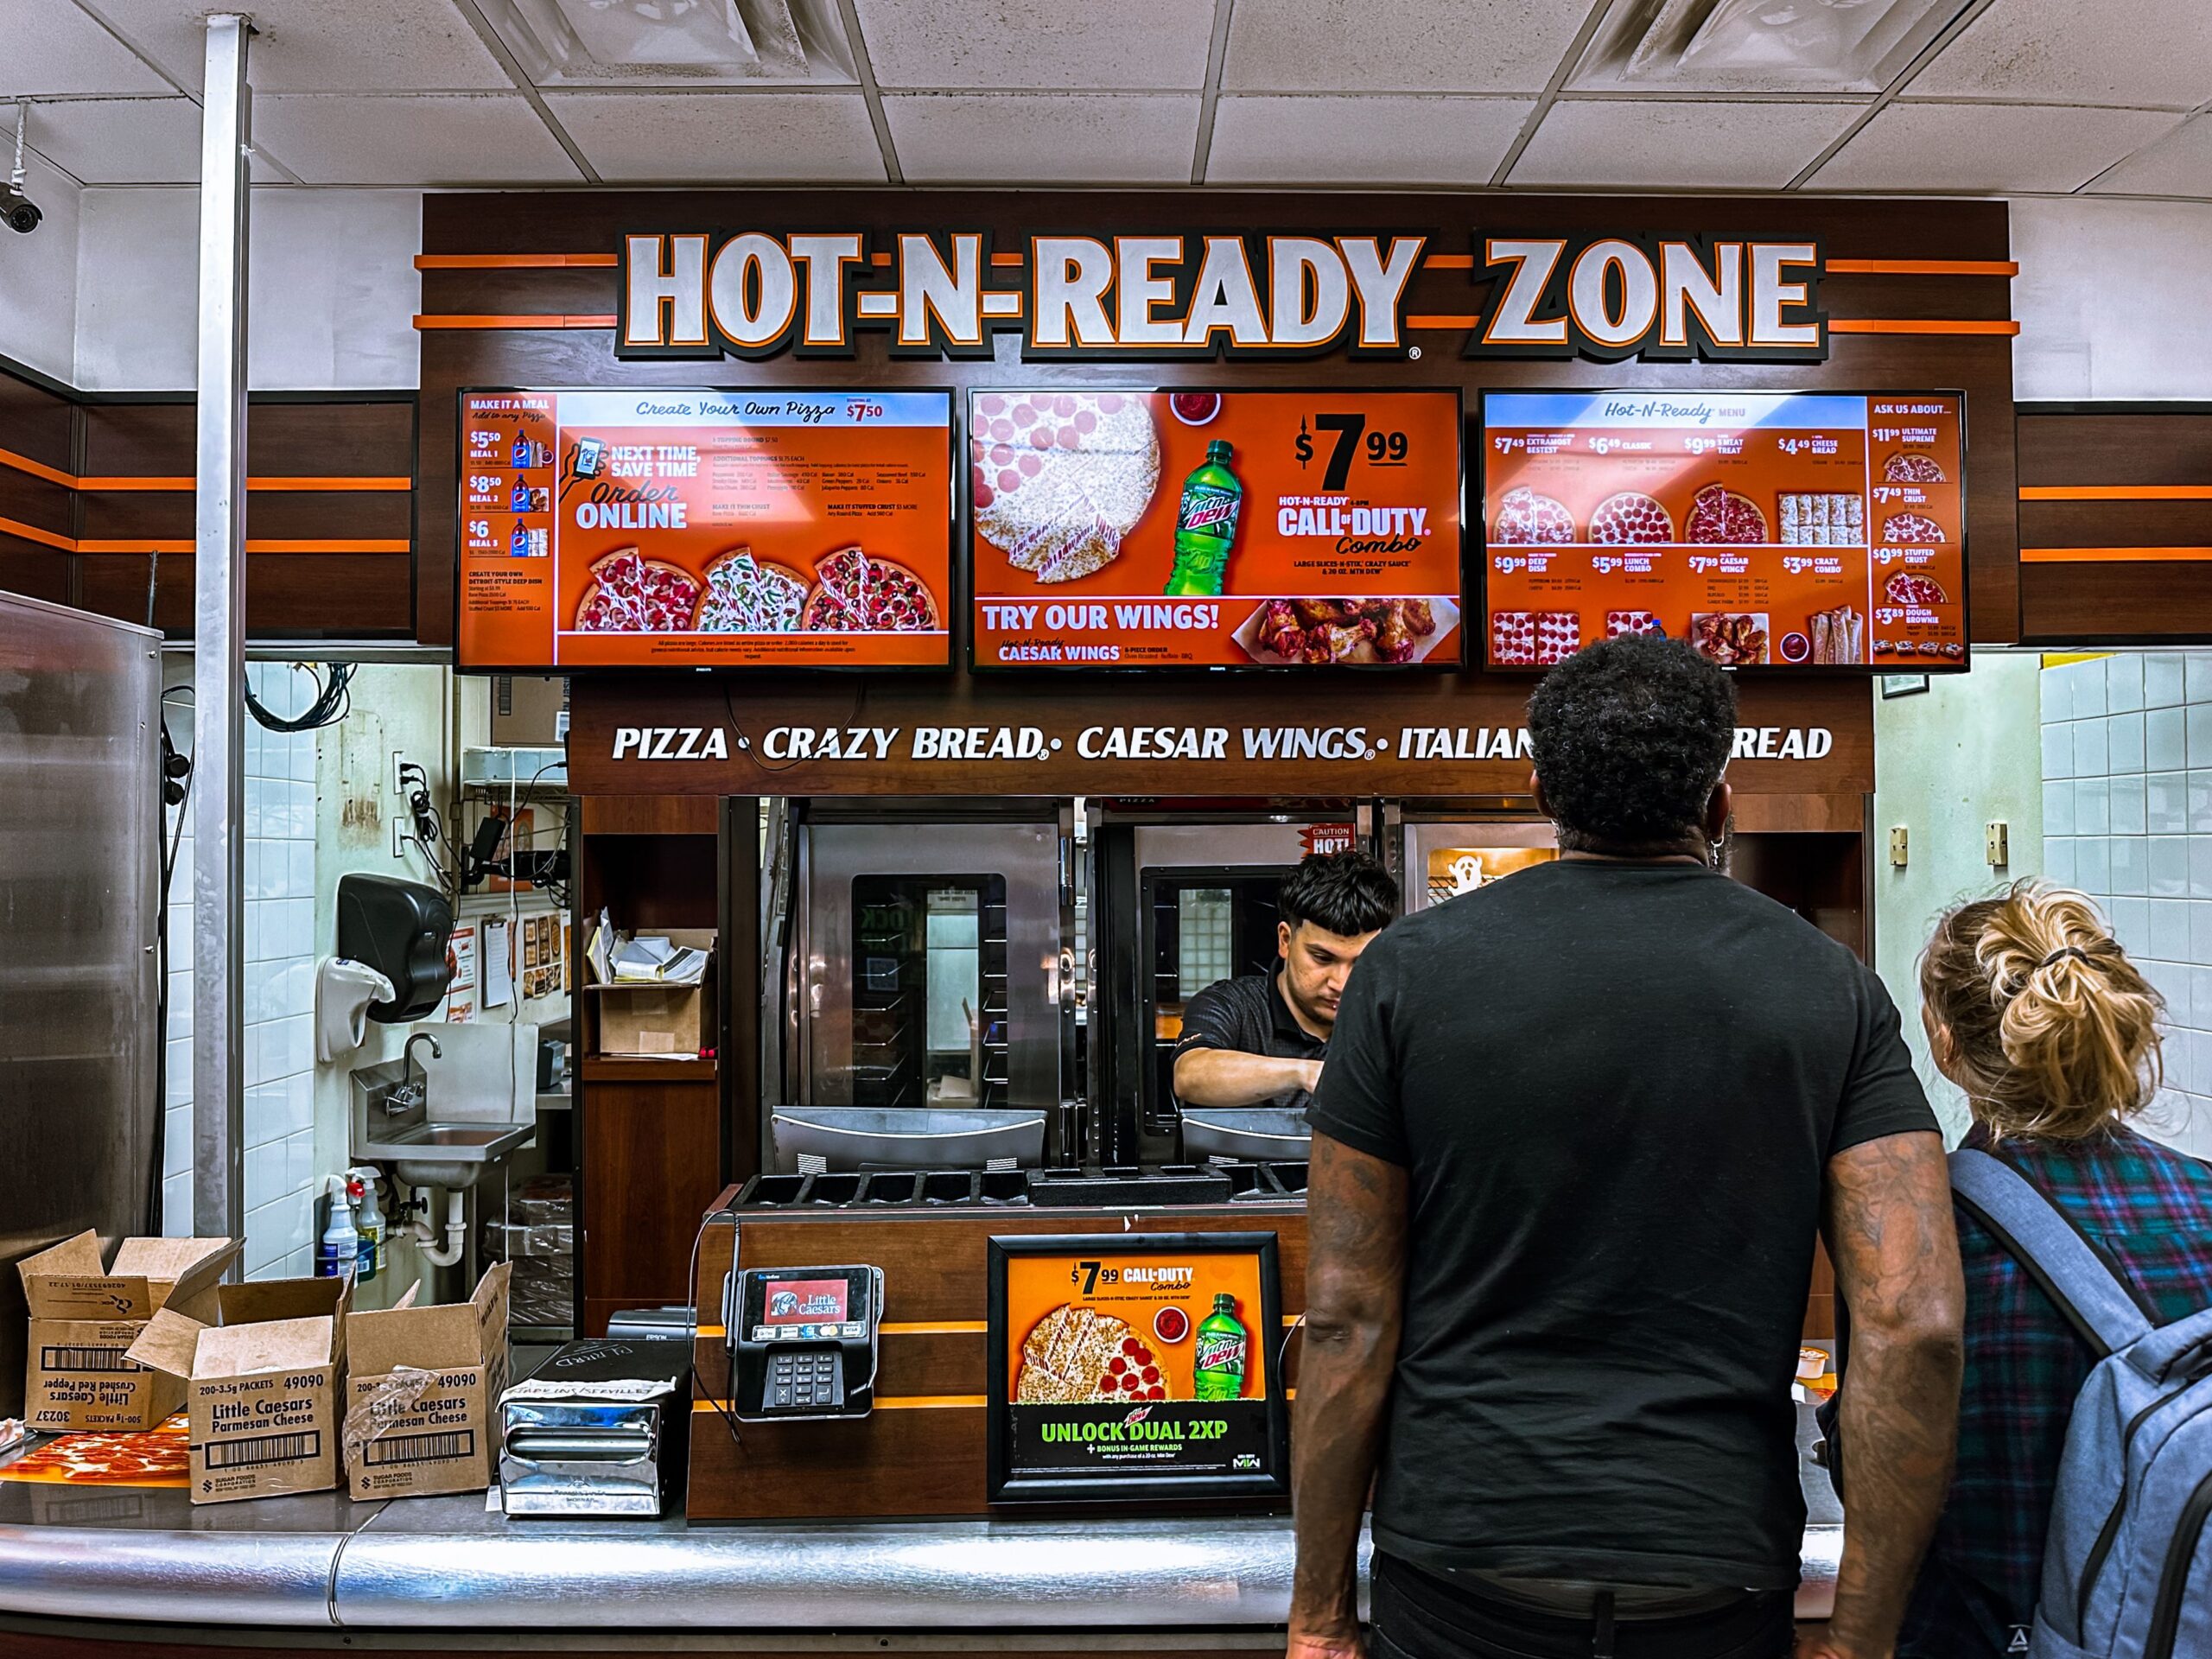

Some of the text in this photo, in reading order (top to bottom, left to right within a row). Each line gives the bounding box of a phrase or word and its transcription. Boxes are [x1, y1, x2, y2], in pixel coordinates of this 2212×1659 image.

[1481, 238, 1819, 348] ZONE
[471, 400, 550, 409] MAKE IT A MEAL
[636, 401, 836, 423] Create Your Own Pizza
[1874, 404, 1894, 414] ASK
[1895, 404, 1909, 414] US
[1605, 402, 1745, 424] Hot-N-Ready MENU
[611, 446, 655, 461] NEXT
[611, 462, 697, 477] SAVE TIME
[591, 480, 679, 504] Order
[575, 502, 688, 529] ONLINE
[1278, 508, 1345, 537] CALL
[1341, 514, 1351, 525] OF
[1335, 532, 1422, 555] Combo
[982, 604, 1219, 631] TRY OUR WINGS!
[998, 645, 1120, 661] CAESAR WINGS
[612, 728, 728, 760] PIZZA
[763, 727, 900, 760] CRAZY
[1077, 726, 1229, 760] CAESAR
[1730, 728, 1833, 760] READ
[1123, 1267, 1154, 1283] CALL
[1158, 1267, 1193, 1282] DUTY
[1150, 1281, 1191, 1291] Combo
[808, 1294, 836, 1306] Little
[798, 1303, 841, 1315] Caesars
[43, 1377, 136, 1393] Crushed Red Pepper
[200, 1374, 324, 1395] 200-3.5g PACKETS 49090
[438, 1373, 476, 1389] 49090
[49, 1391, 129, 1406] Little Caesars
[410, 1397, 466, 1413] Caesars
[35, 1410, 70, 1422] 30237
[212, 1398, 313, 1420] Little Caesars
[85, 1414, 114, 1423] PACKETS
[212, 1413, 314, 1433] Parmesan Cheese
[429, 1412, 467, 1425] Cheese
[1041, 1421, 1228, 1442] UNLOCK DUAL 2XP
[1121, 1444, 1149, 1452] IN-GAME
[1150, 1443, 1183, 1452] REWARDS
